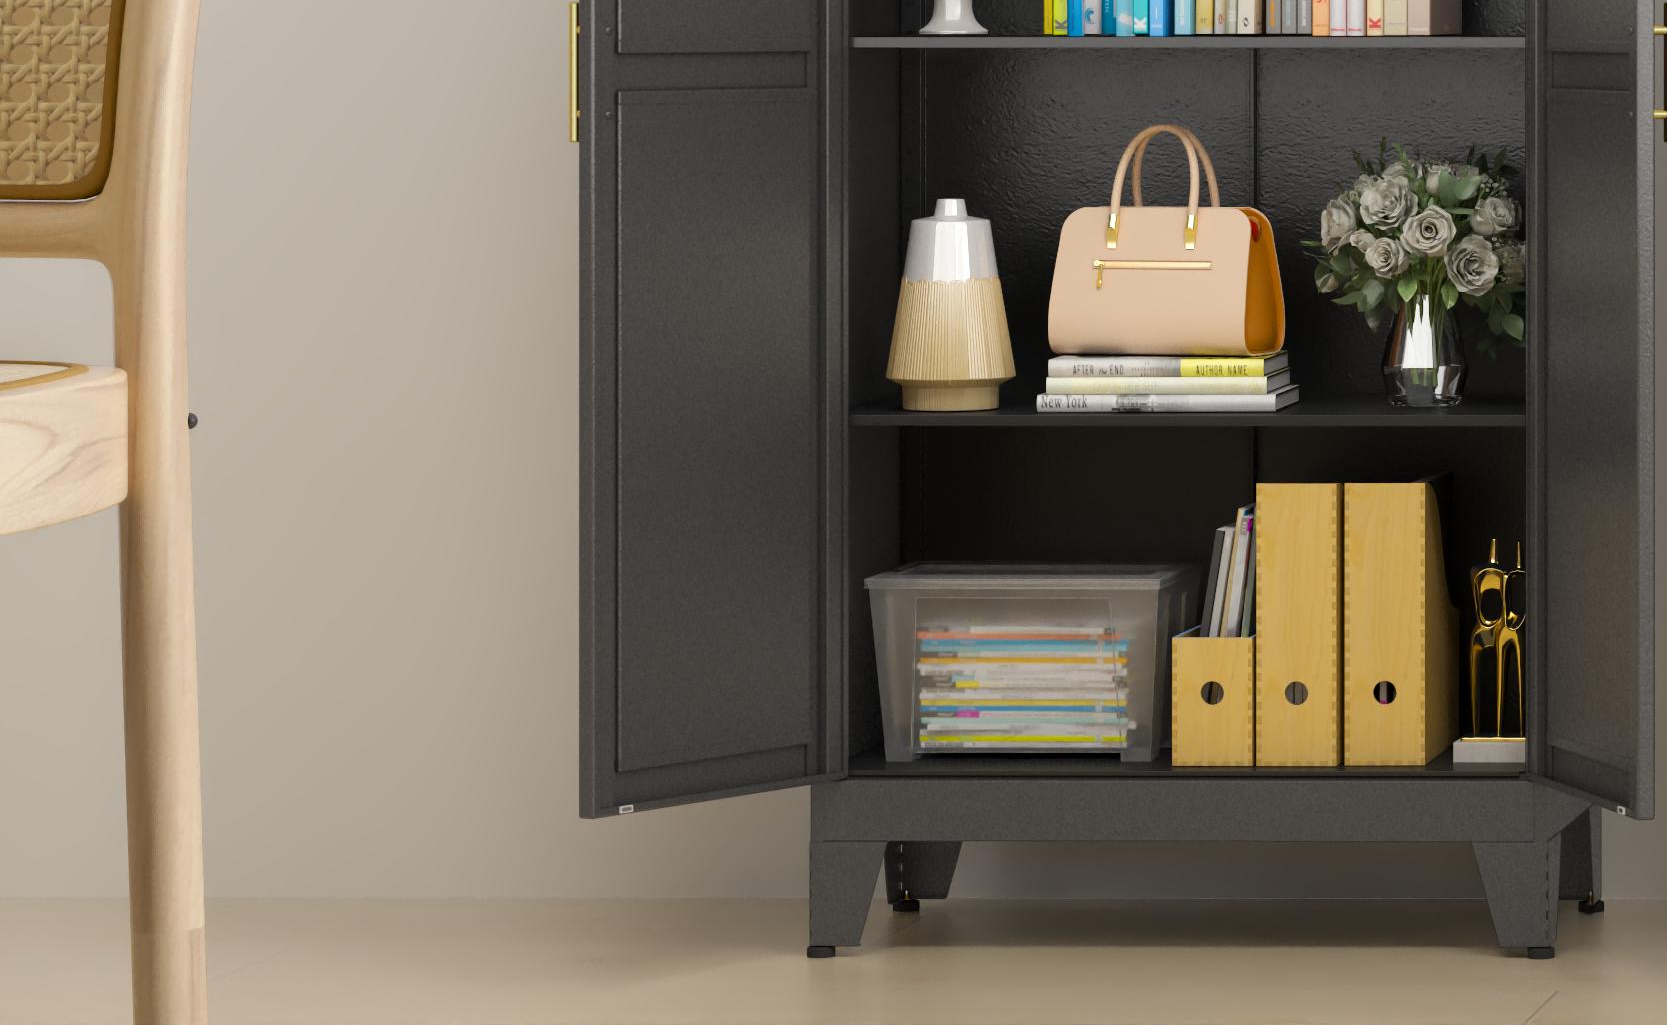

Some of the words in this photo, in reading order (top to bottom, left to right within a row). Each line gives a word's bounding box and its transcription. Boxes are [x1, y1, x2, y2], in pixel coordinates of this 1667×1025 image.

[1072, 364, 1095, 376] AFTER
[1109, 364, 1124, 376] END
[1195, 364, 1223, 376] AUTHOR
[1227, 364, 1248, 376] NAME
[1041, 394, 1062, 409] New
[1065, 394, 1088, 409] York
